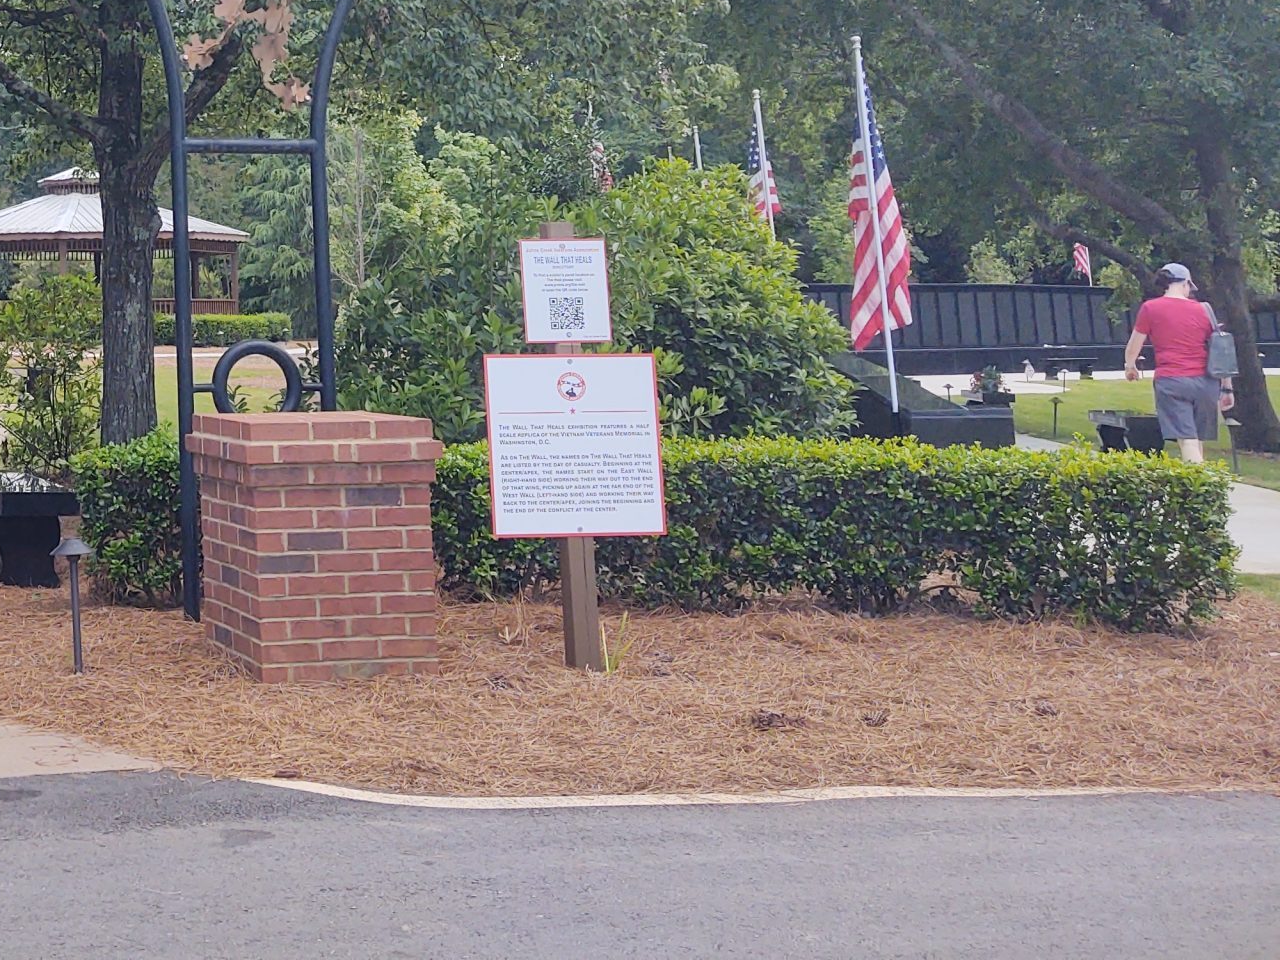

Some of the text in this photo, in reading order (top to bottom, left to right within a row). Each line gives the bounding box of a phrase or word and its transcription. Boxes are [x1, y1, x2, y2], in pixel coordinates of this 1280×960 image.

[534, 255, 593, 264] THE WALL THAT HEALS
